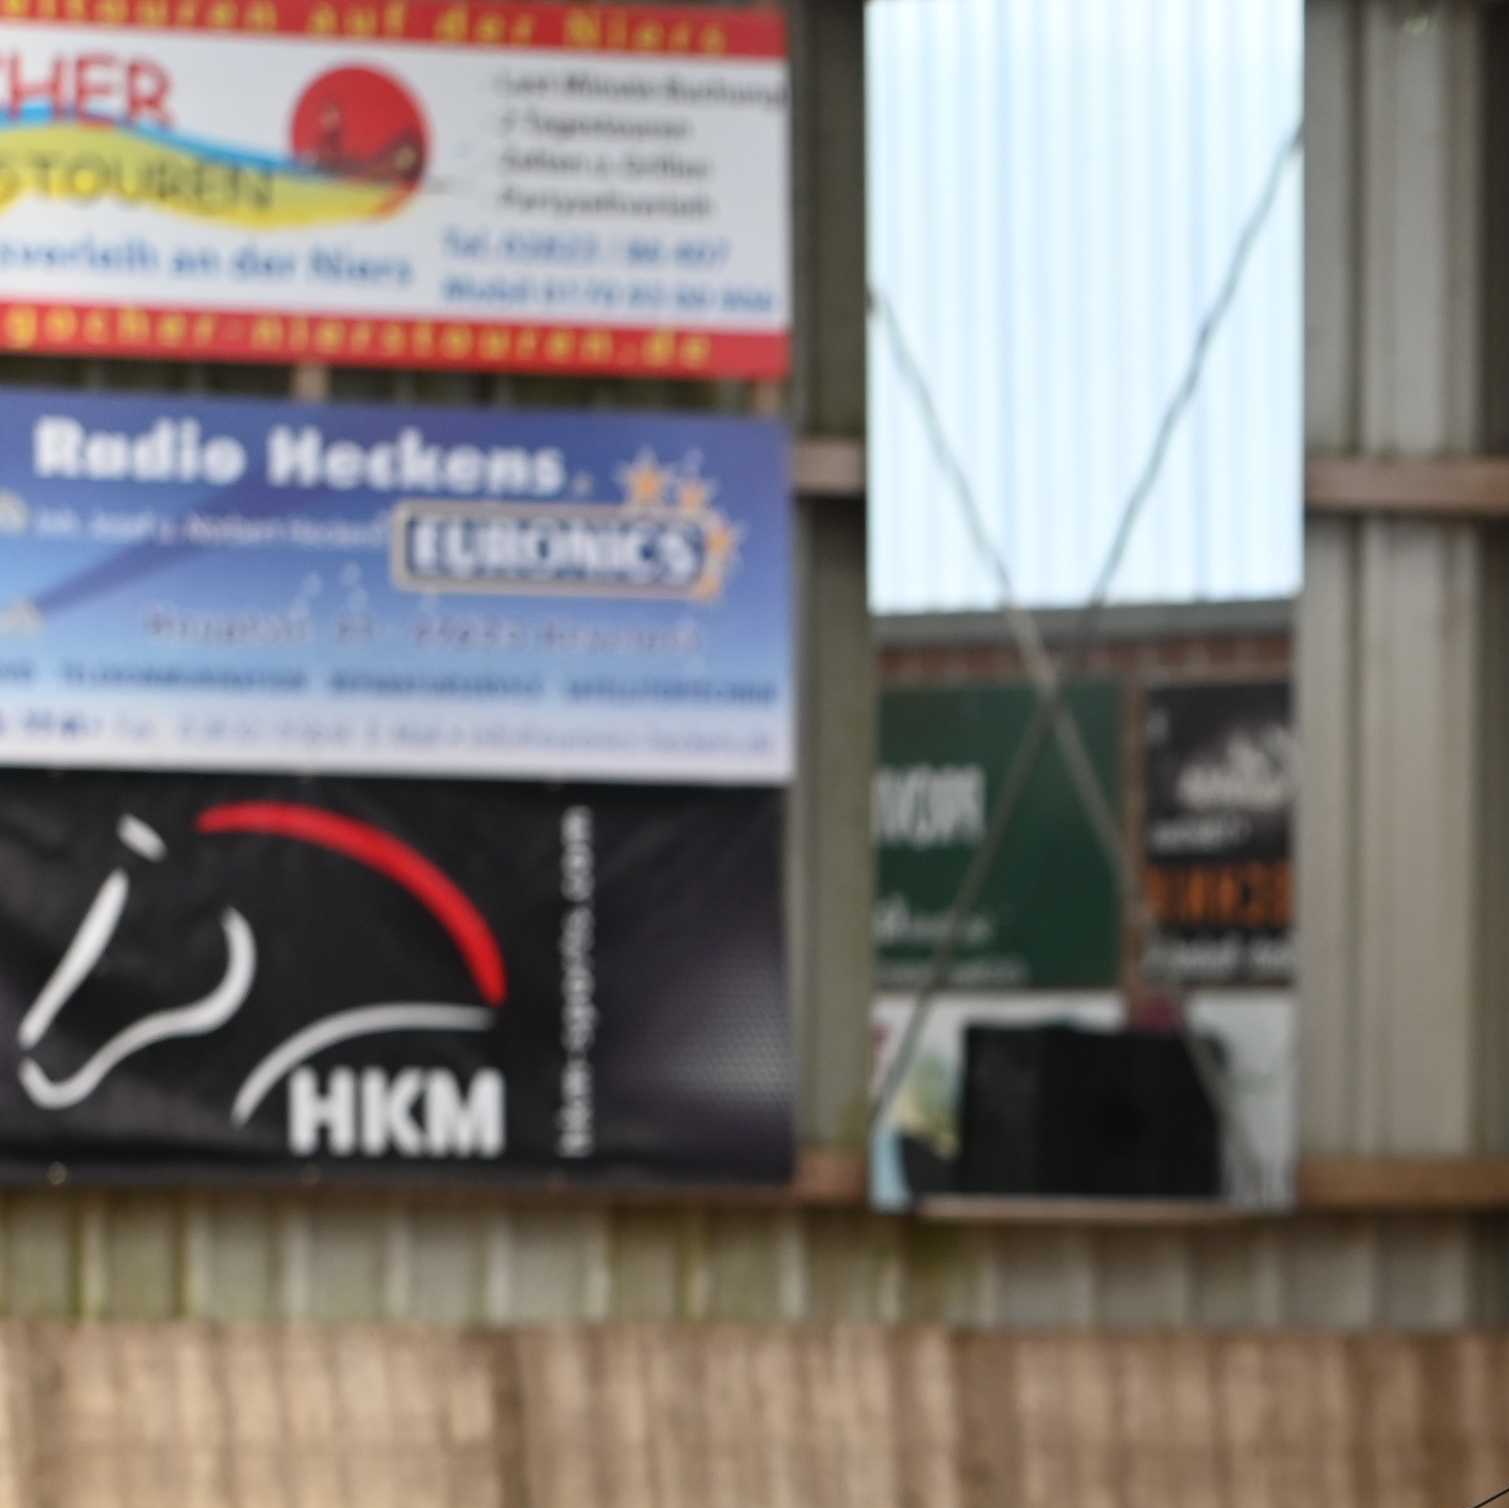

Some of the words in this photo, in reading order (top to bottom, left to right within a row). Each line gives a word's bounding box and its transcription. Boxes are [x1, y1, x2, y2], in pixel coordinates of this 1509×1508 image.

[0, 50, 175, 130] HER
[34, 416, 247, 484] Radio
[410, 520, 702, 584] EURONICS
[287, 1064, 506, 1158] HKM
